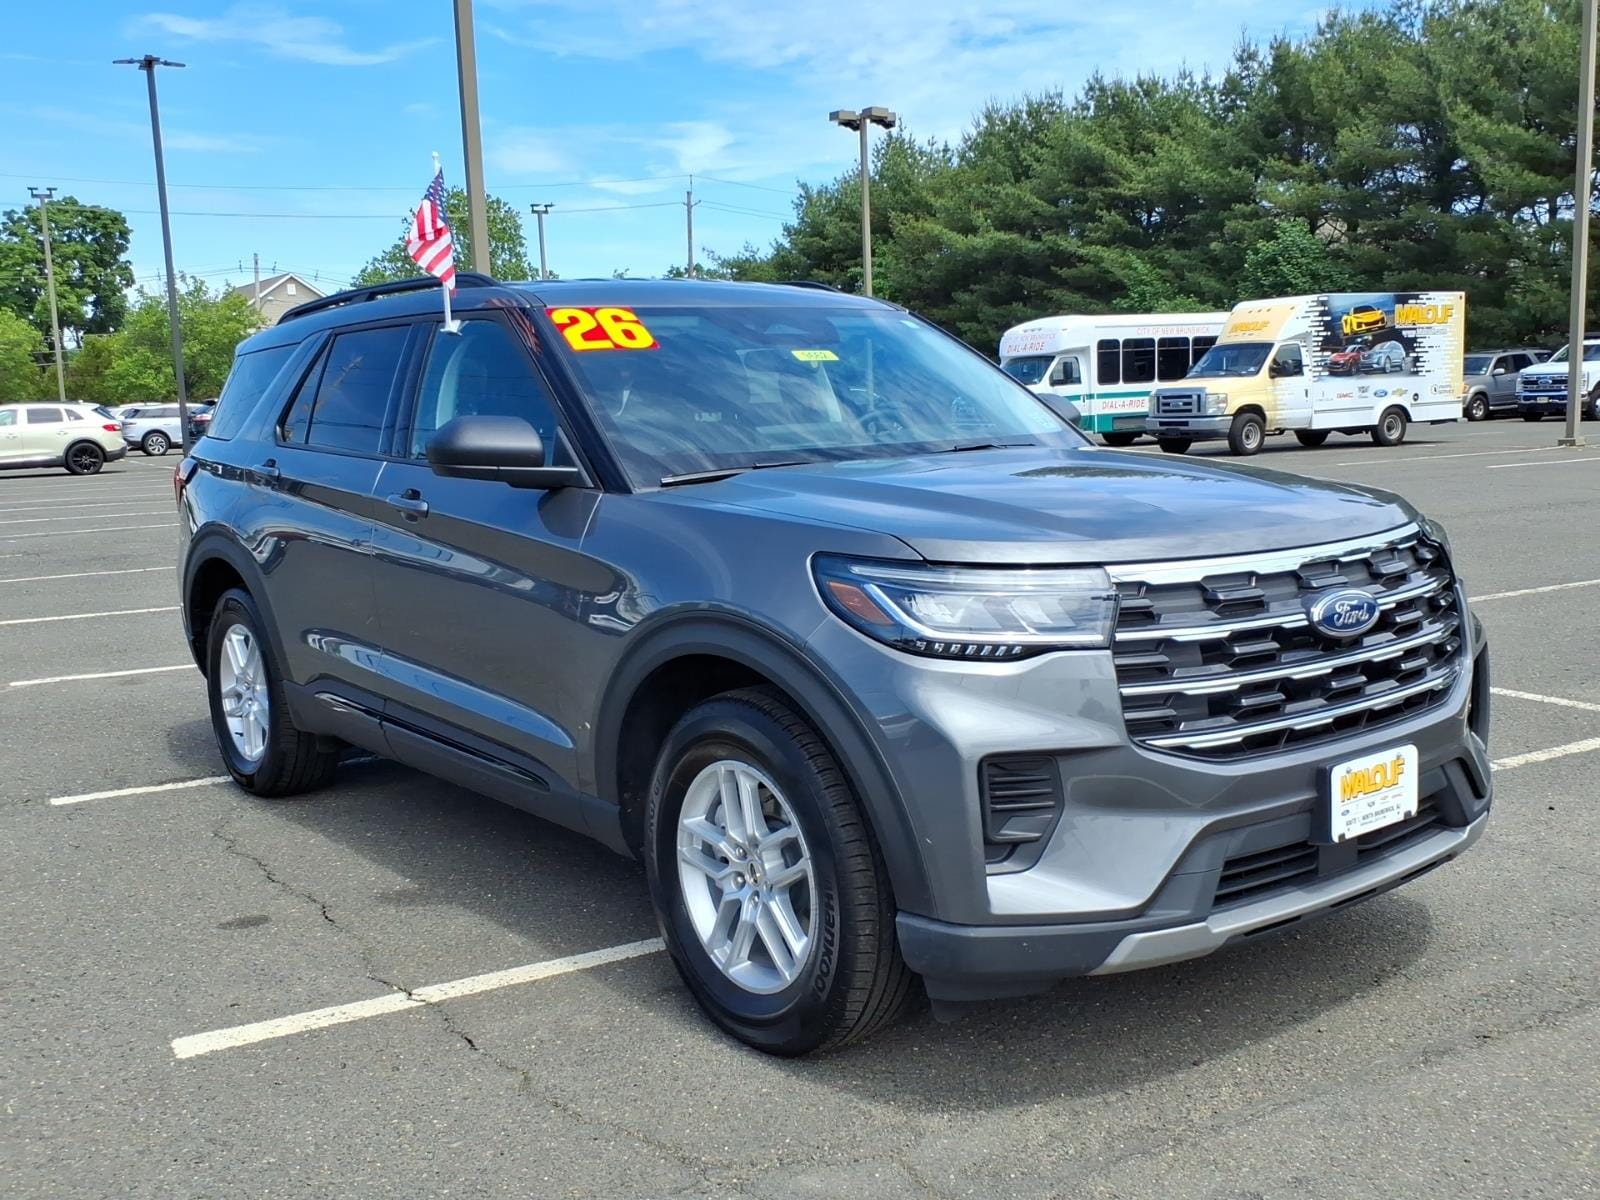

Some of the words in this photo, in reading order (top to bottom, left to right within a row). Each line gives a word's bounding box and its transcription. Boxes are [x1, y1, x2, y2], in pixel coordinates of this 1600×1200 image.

[1395, 304, 1454, 325] MALOUF
[550, 307, 655, 351] 26
[1136, 327, 1150, 336] CITY
[1152, 327, 1159, 335] OF
[1161, 327, 1175, 335] NEW
[1176, 326, 1209, 335] BRUNSWICK
[1007, 341, 1045, 353] DIAL-A-RIDE
[1102, 399, 1145, 410] DIAL-A-RIDE
[1333, 599, 1369, 627] Ford
[1341, 756, 1405, 803] MALOUF
